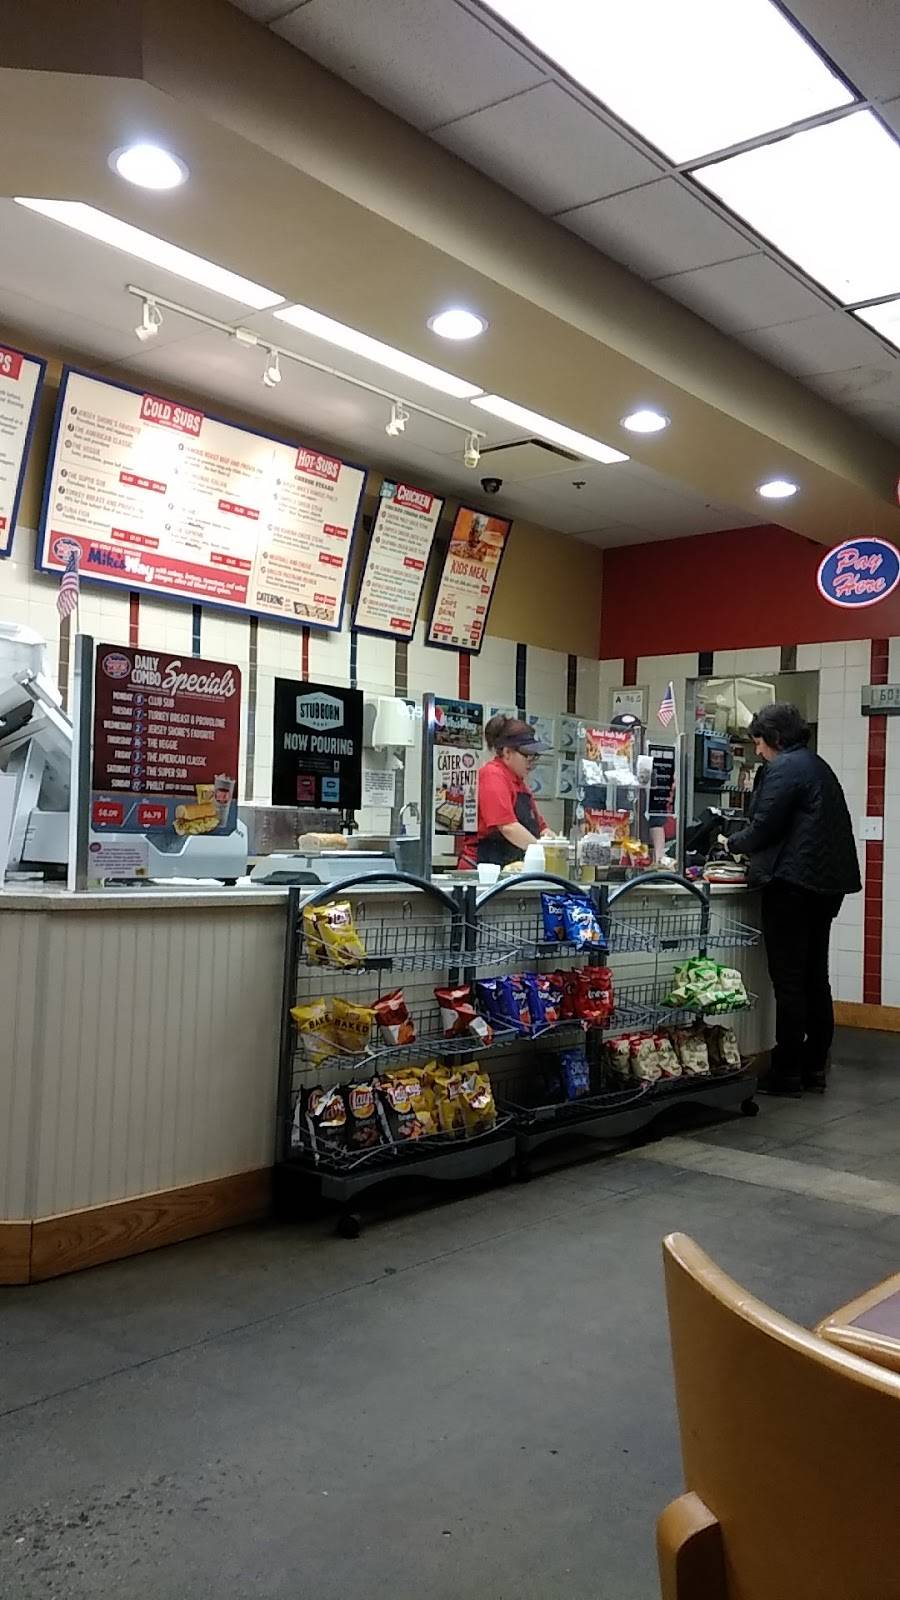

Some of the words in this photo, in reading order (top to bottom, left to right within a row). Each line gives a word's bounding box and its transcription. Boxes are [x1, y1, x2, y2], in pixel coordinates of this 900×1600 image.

[143, 397, 171, 420] COLD
[173, 407, 201, 432] SUBS
[297, 449, 315, 468] HOT
[316, 456, 339, 478] SUBS
[124, 555, 154, 582] Way
[836, 548, 883, 574] Pay
[450, 560, 468, 576] KIDS
[469, 564, 489, 582] MEAL
[832, 572, 886, 597] Here
[256, 591, 284, 606] CATERING
[135, 655, 159, 671] DAILY
[131, 669, 161, 686] COMBO
[162, 660, 236, 697] Specials
[148, 696, 163, 708] CLUB
[163, 697, 175, 708] SUB
[147, 710, 169, 721] TURKEY
[170, 712, 190, 724] BREAST
[300, 703, 340, 720] STUBBORN
[147, 724, 167, 735] JERSEY
[147, 738, 158, 748] THE
[159, 739, 178, 750] VEGGIE
[284, 733, 308, 751] NOW
[310, 735, 353, 756] POURING
[146, 752, 158, 762] THE
[158, 753, 186, 765] AMERICAN
[186, 755, 207, 766] CLASSIC
[438, 754, 461, 770] CATER
[146, 766, 158, 776] THE
[158, 767, 175, 778] SUPER
[175, 768, 188, 778] SUB
[452, 770, 478, 787] EVENT!
[145, 780, 165, 791] PHILLY
[309, 1013, 331, 1029] BAKE
[334, 1018, 369, 1033] BAKED
